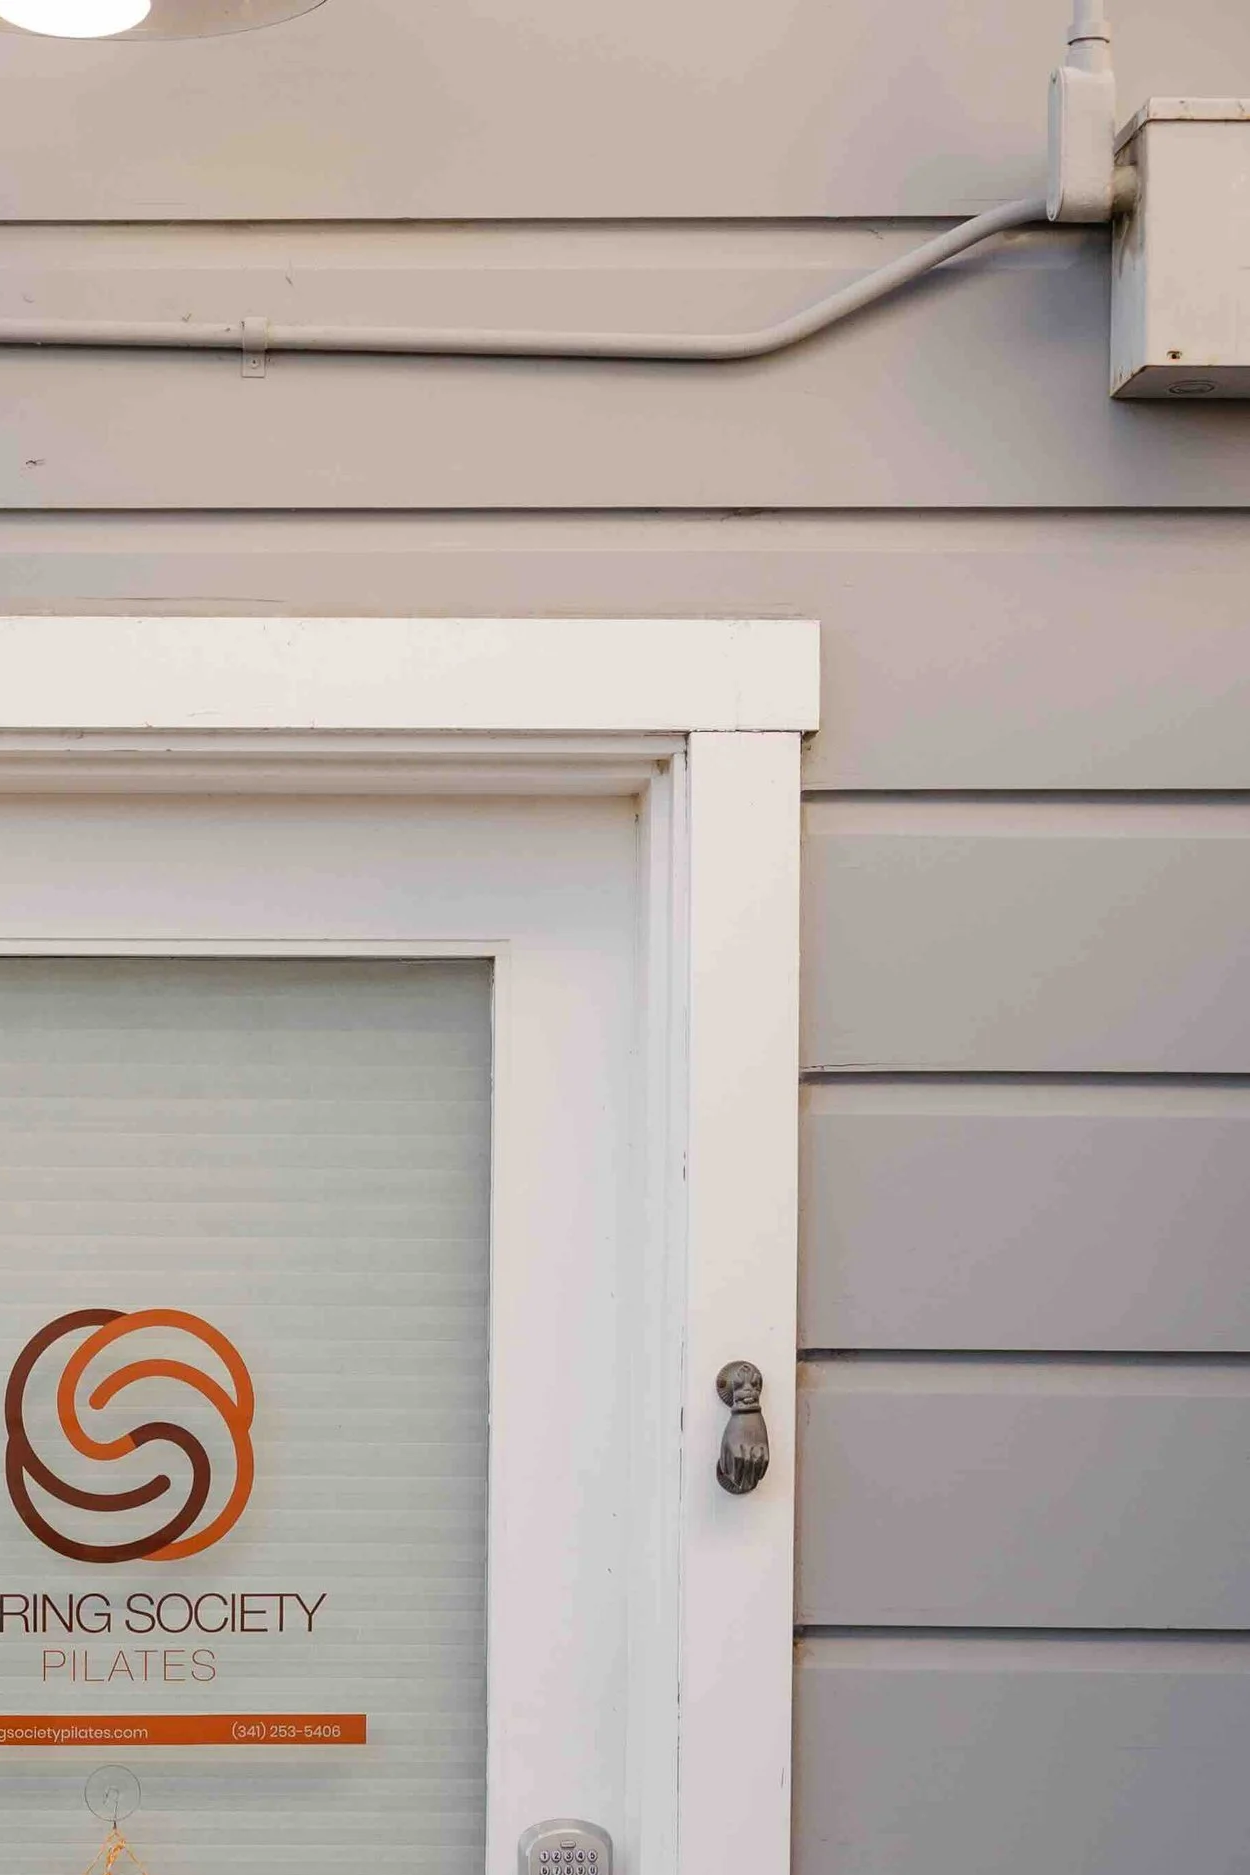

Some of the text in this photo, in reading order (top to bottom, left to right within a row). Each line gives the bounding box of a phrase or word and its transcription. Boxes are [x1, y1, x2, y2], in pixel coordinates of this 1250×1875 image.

[125, 1592, 327, 1634] SOCIETY
[41, 1648, 217, 1683] PILATES
[230, 1721, 266, 1741] (341)
[269, 1723, 342, 1739] 253-5406
